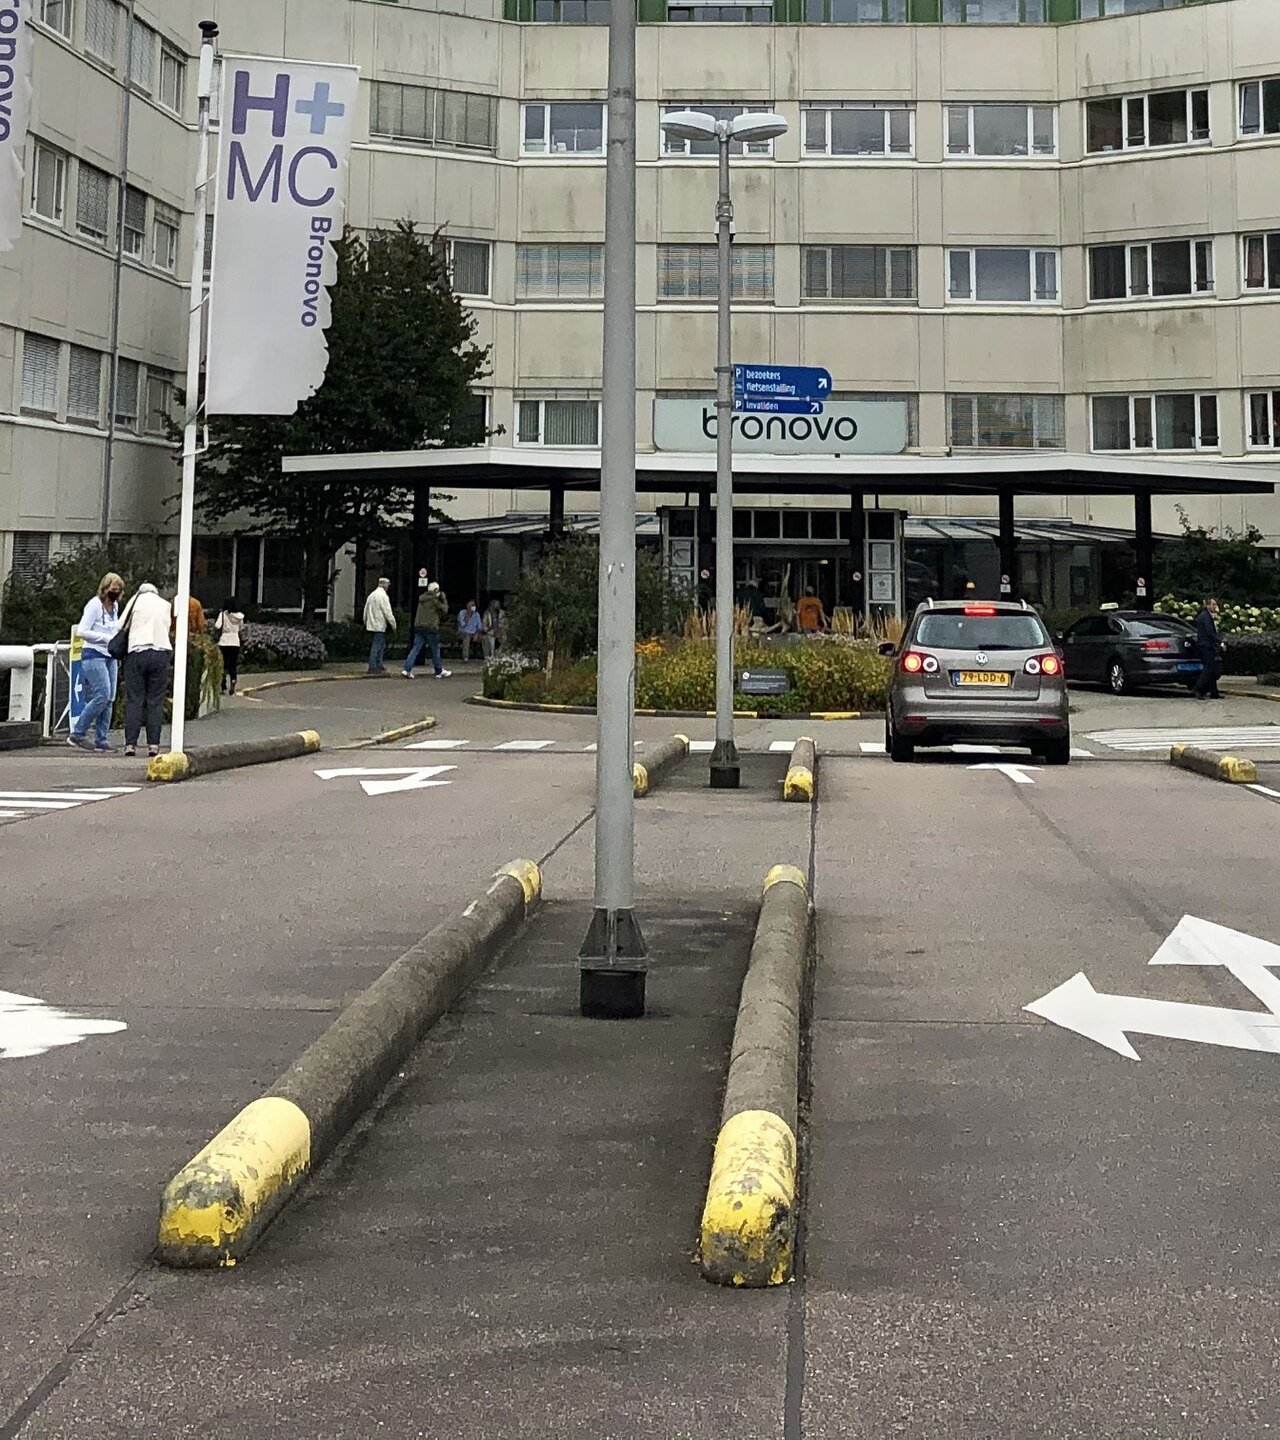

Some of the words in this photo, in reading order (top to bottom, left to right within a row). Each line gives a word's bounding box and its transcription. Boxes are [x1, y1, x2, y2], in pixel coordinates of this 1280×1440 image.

[226, 141, 339, 207] MC
[299, 216, 332, 327] Bronovo
[746, 370, 780, 380] bezoekers
[703, 408, 858, 441] bronovo
